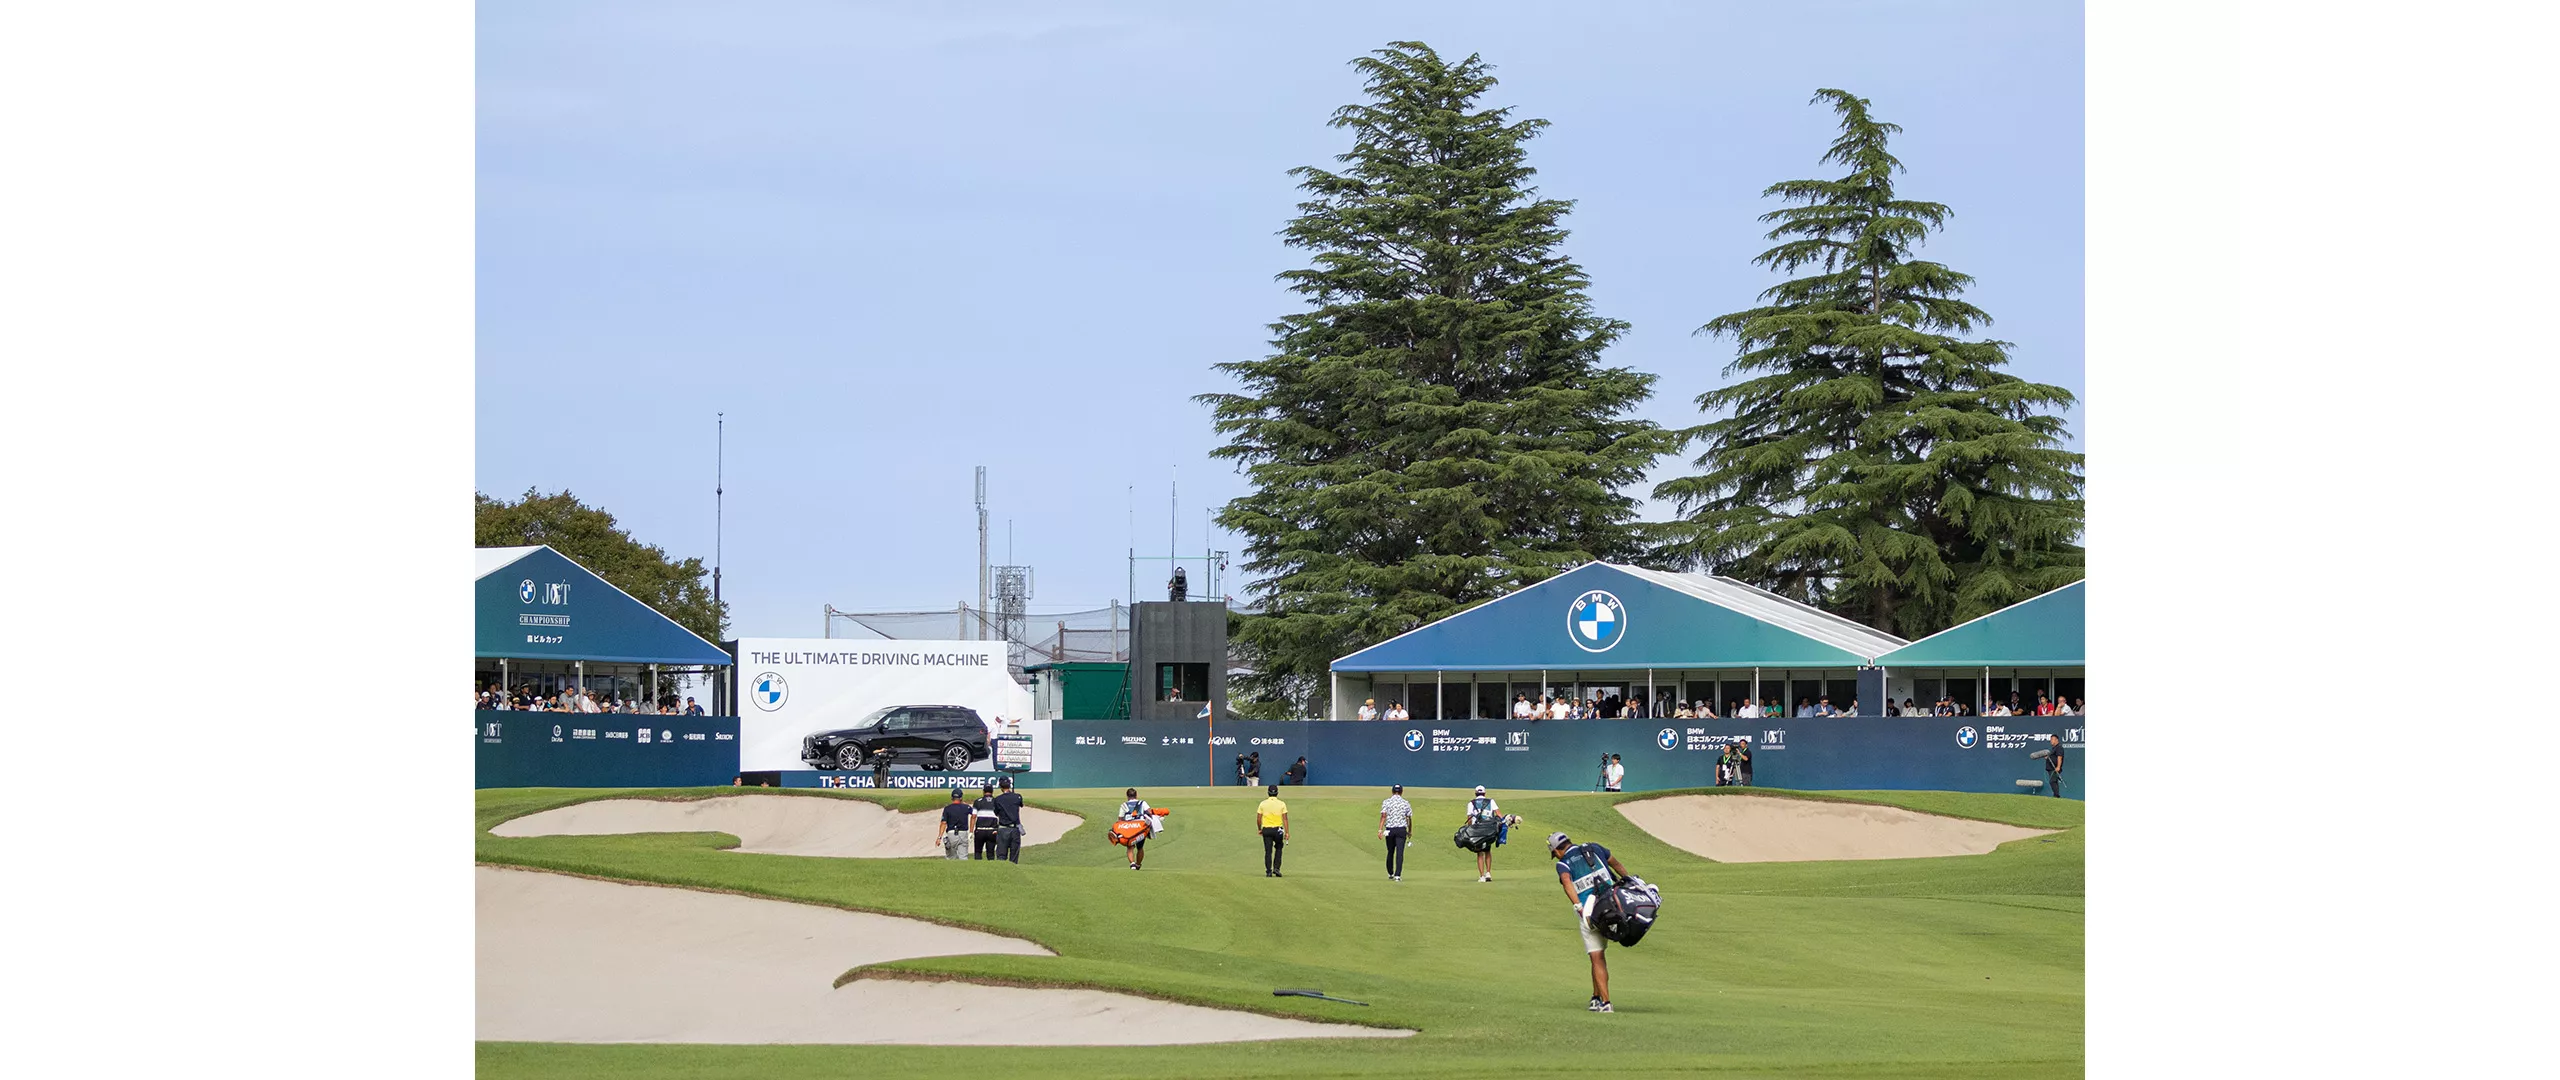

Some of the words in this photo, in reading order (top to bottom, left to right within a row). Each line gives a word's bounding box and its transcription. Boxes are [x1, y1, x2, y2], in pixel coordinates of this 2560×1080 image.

[1575, 593, 1619, 612] BMW
[519, 615, 571, 625] CHAMPIONSHIP
[751, 652, 781, 665] THE
[784, 652, 858, 665] ULTIMATE
[862, 653, 920, 666] DRIVING
[924, 653, 989, 667] MACHINE
[1075, 736, 1106, 745] 森ビル
[949, 776, 985, 788] PRIZE
